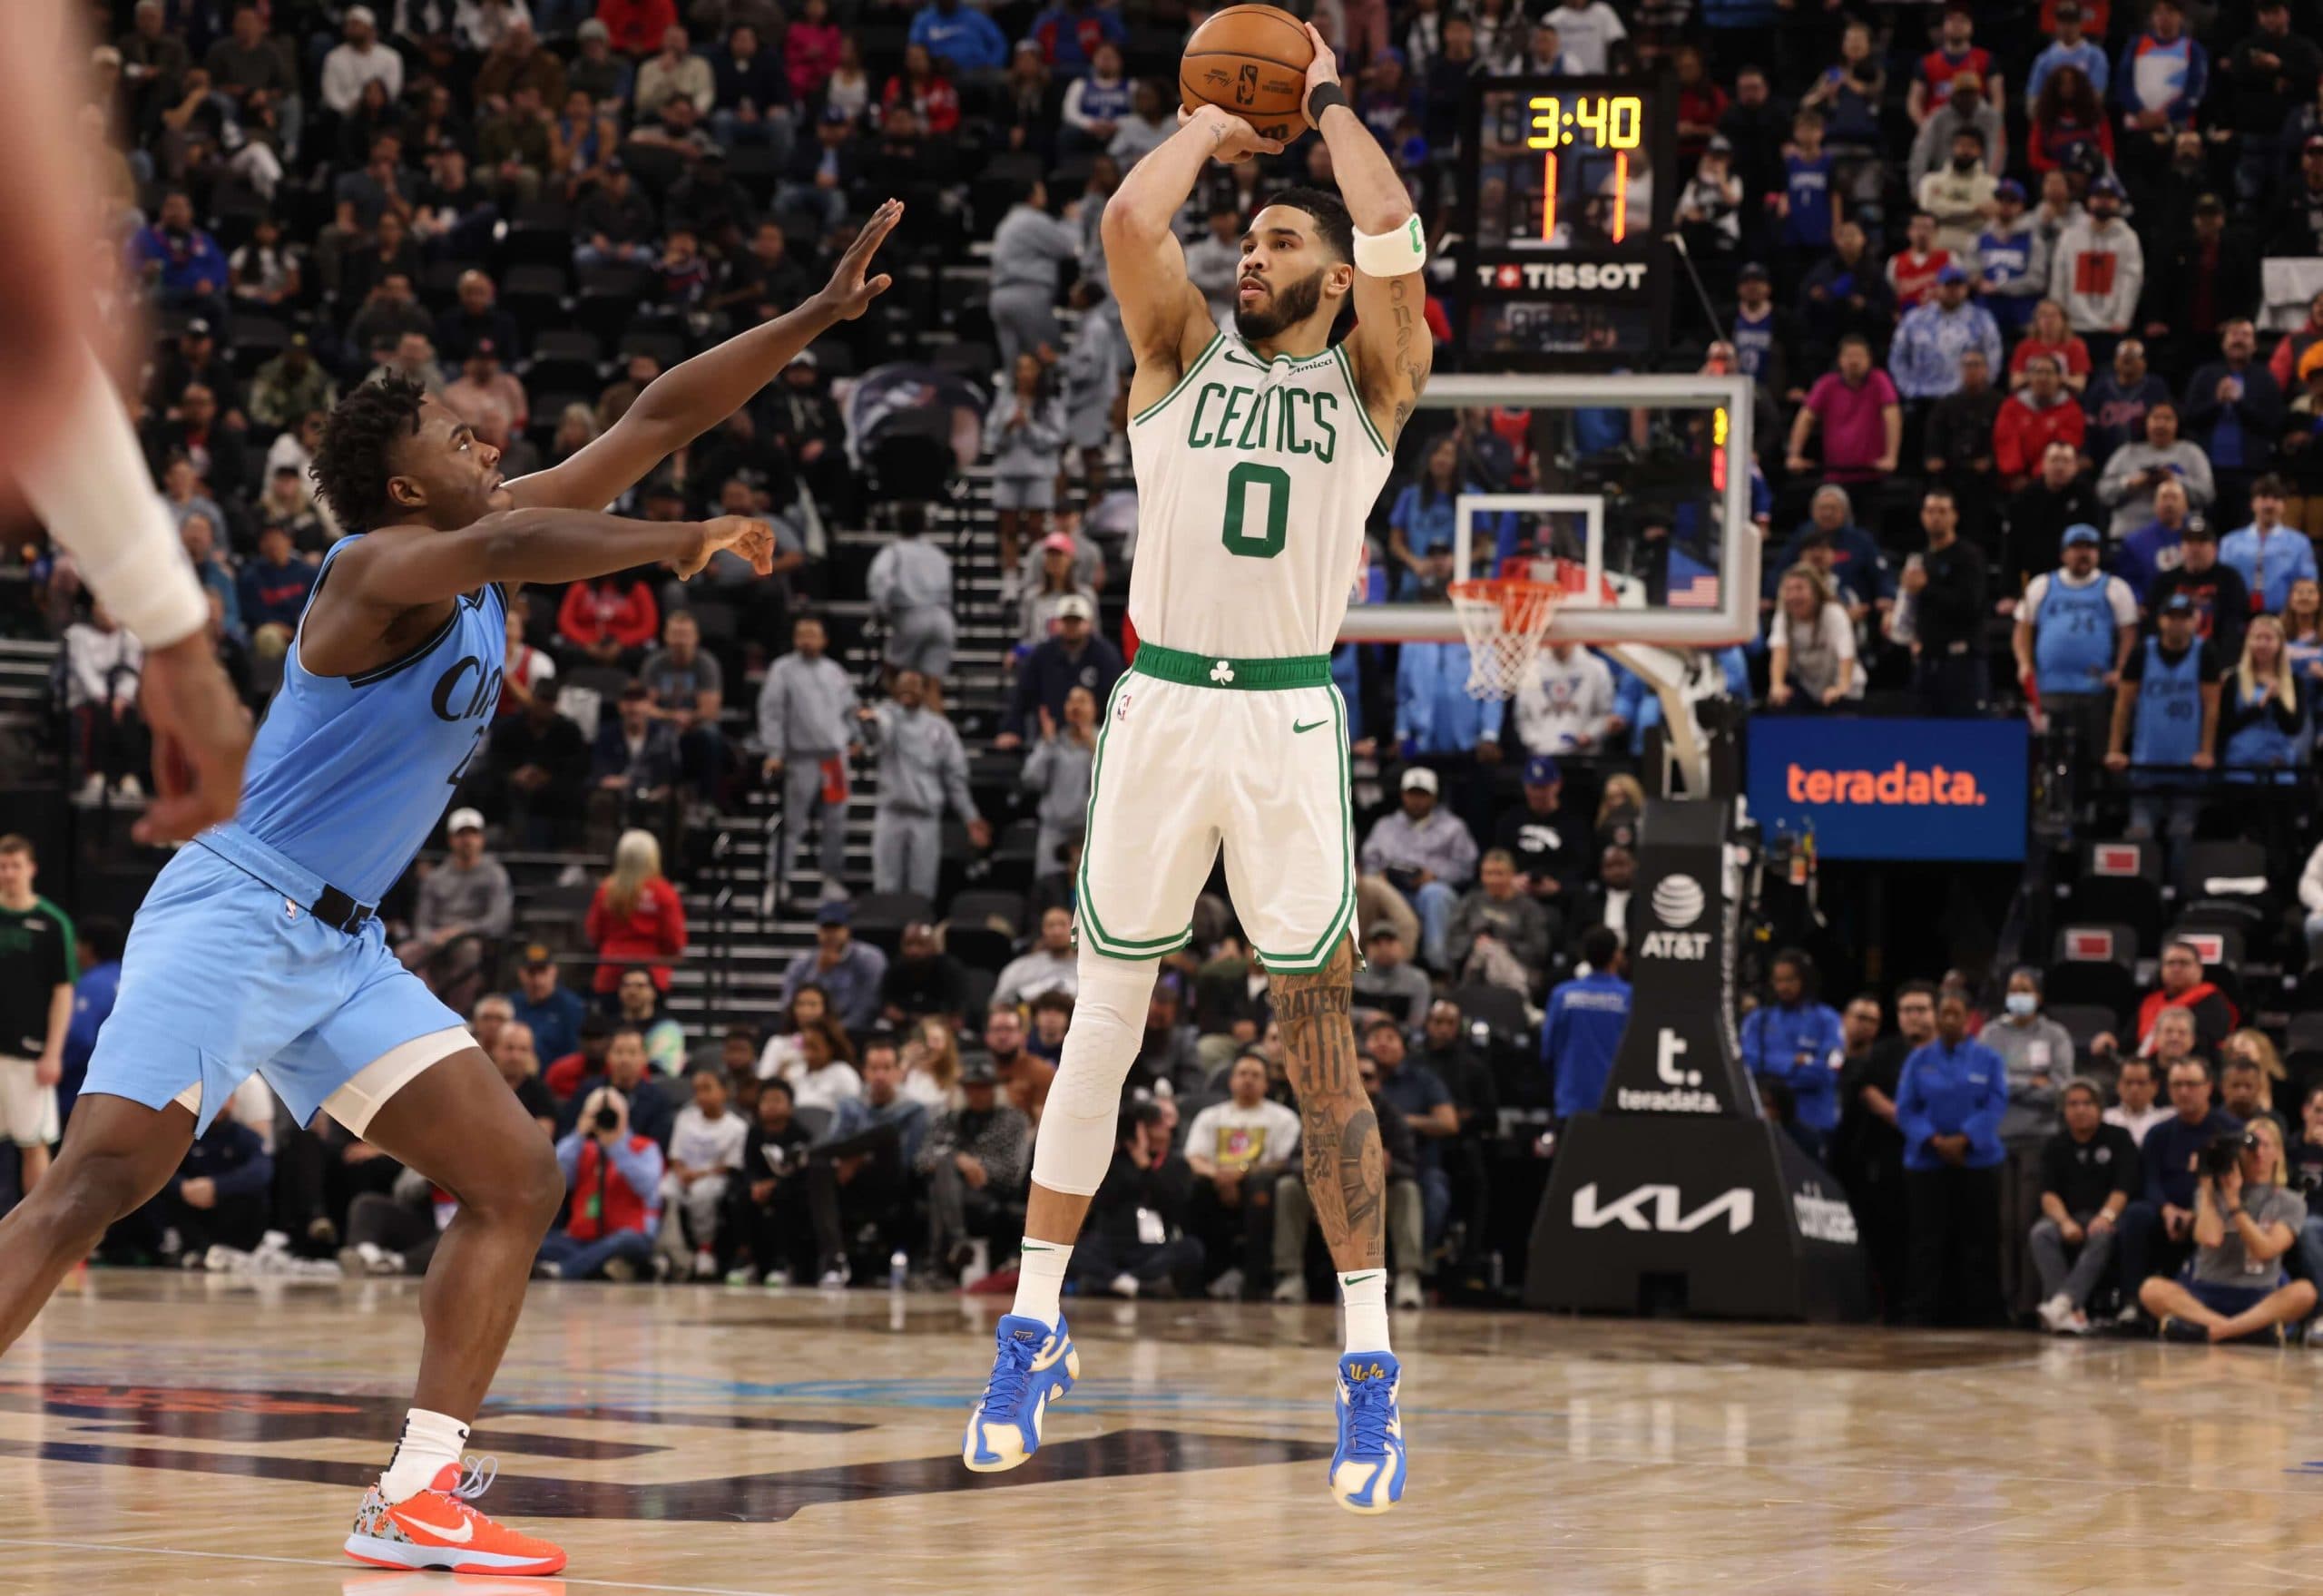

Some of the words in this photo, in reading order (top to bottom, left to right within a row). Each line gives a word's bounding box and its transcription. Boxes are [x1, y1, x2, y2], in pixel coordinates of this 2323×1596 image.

[1528, 97, 1642, 149] 3:40
[1543, 151, 1628, 243] 11
[1523, 263, 1648, 289] TISSOT
[1188, 382, 1338, 465] CELTICS
[1221, 461, 1290, 559] 0
[1787, 760, 1987, 806] teradata.
[1641, 932, 1711, 961] AT&T
[1618, 1088, 1722, 1114] teradata.
[1572, 1182, 1755, 1235] KIA
